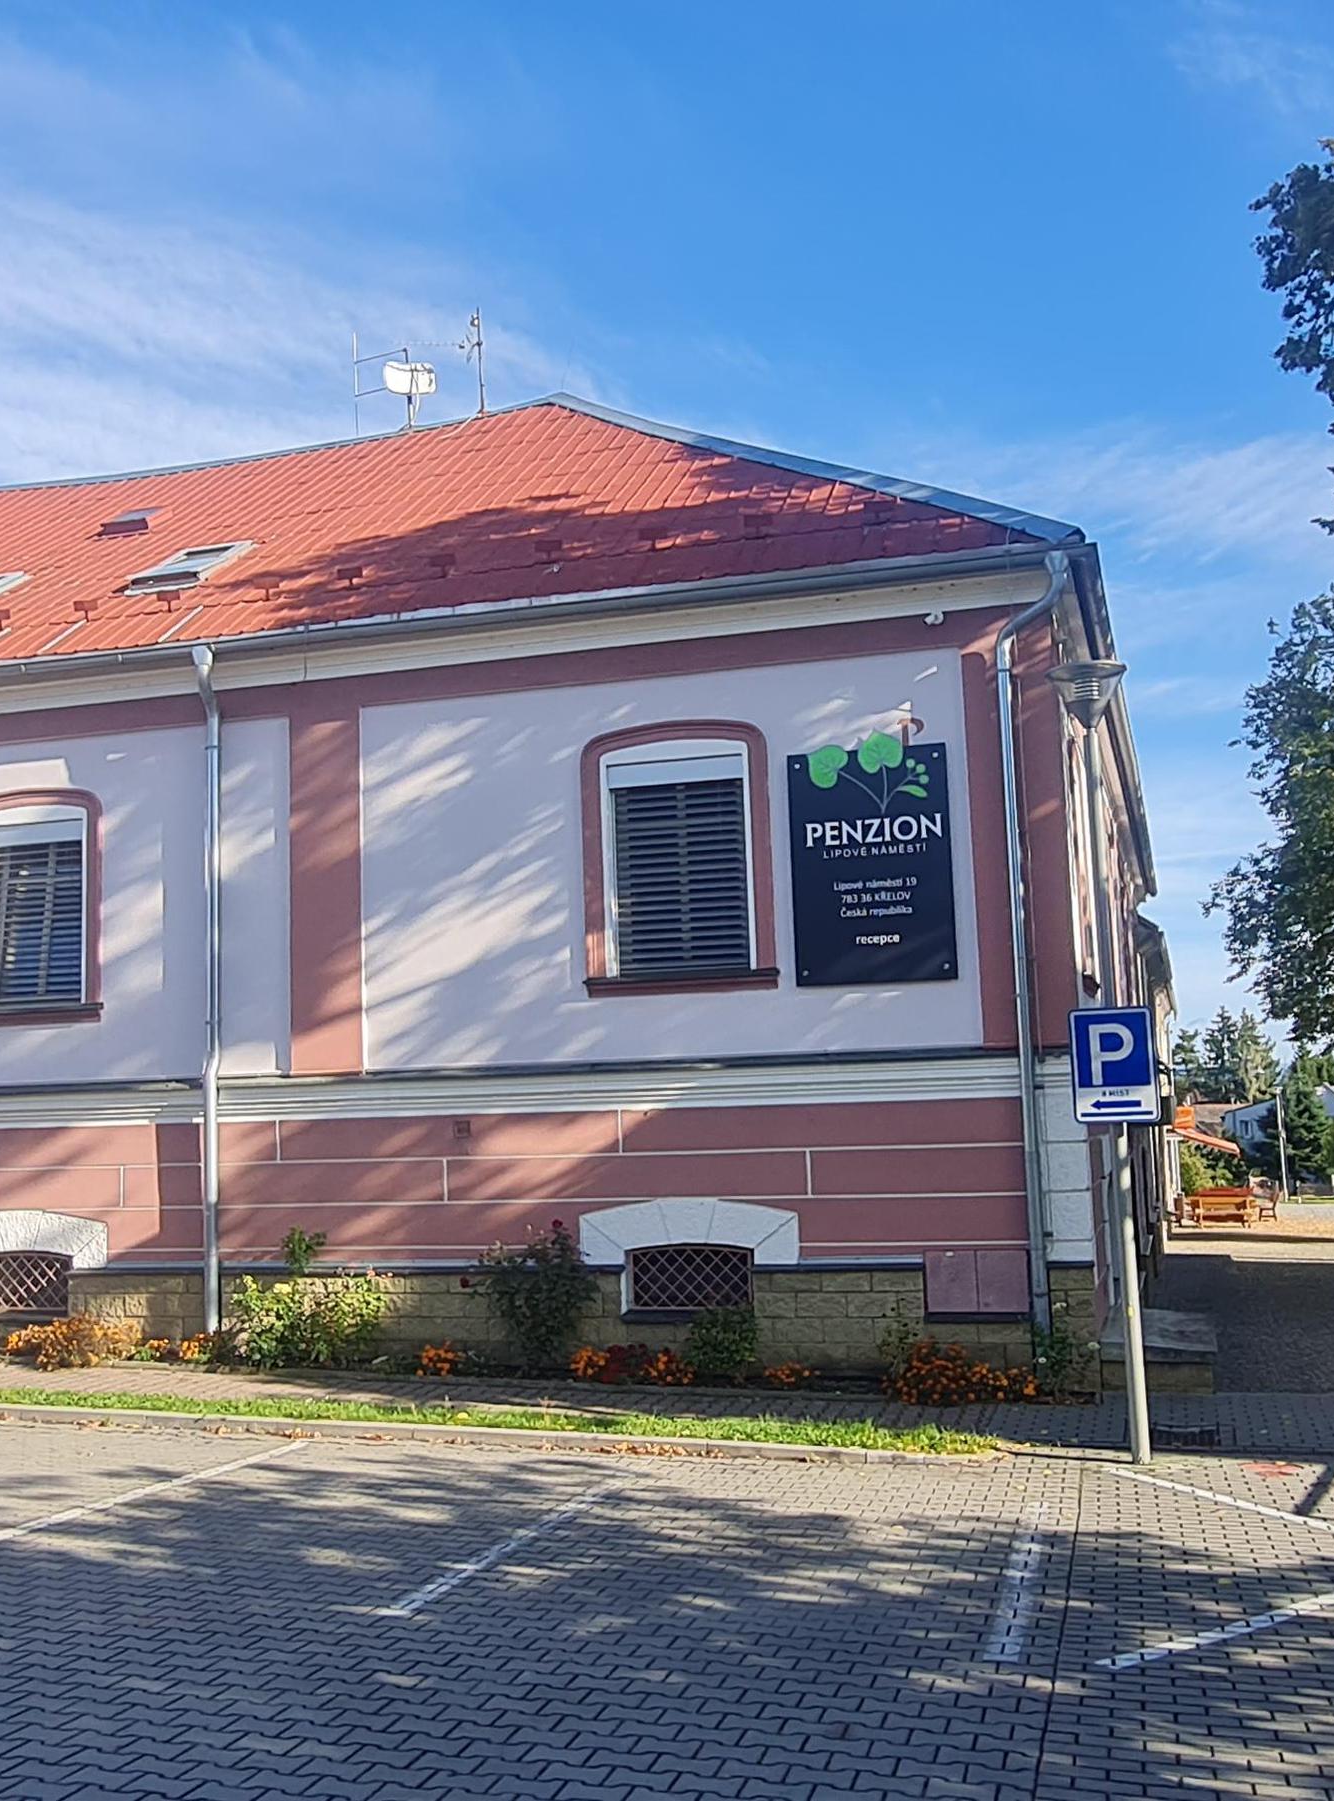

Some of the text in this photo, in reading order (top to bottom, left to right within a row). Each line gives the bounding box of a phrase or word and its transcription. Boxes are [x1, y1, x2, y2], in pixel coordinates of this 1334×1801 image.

[805, 813, 942, 847] PENZION
[823, 842, 926, 859] LIPOVÉ NÁMĚSTÍ
[833, 876, 917, 892] Lipové náměstí 19
[841, 891, 911, 904] 783 36 KŘELOV
[840, 905, 913, 918] Česká republika
[855, 934, 900, 946] recepce
[1088, 1023, 1134, 1086] P
